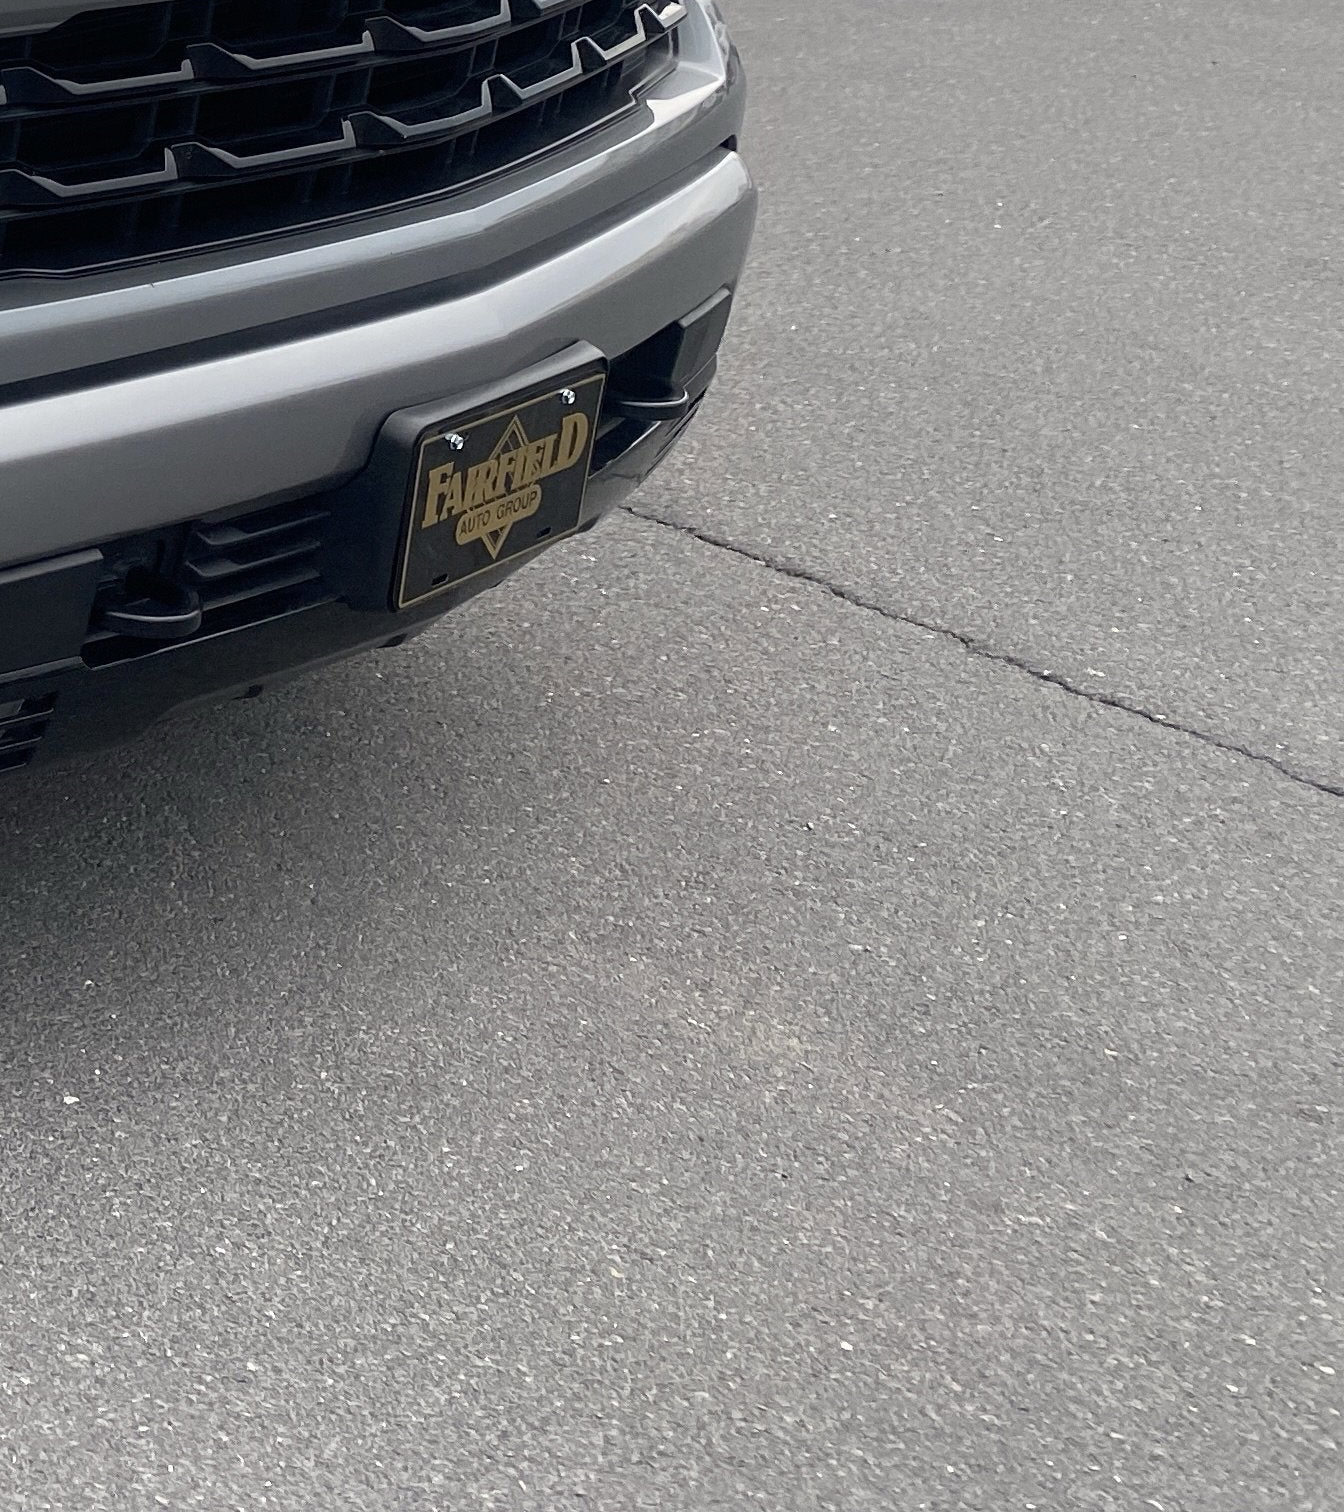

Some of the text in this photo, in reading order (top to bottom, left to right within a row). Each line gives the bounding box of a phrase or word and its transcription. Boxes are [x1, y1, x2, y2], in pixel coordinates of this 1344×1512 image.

[422, 412, 589, 528] FAIRFIELD
[458, 490, 539, 537] AUTO GROUP
